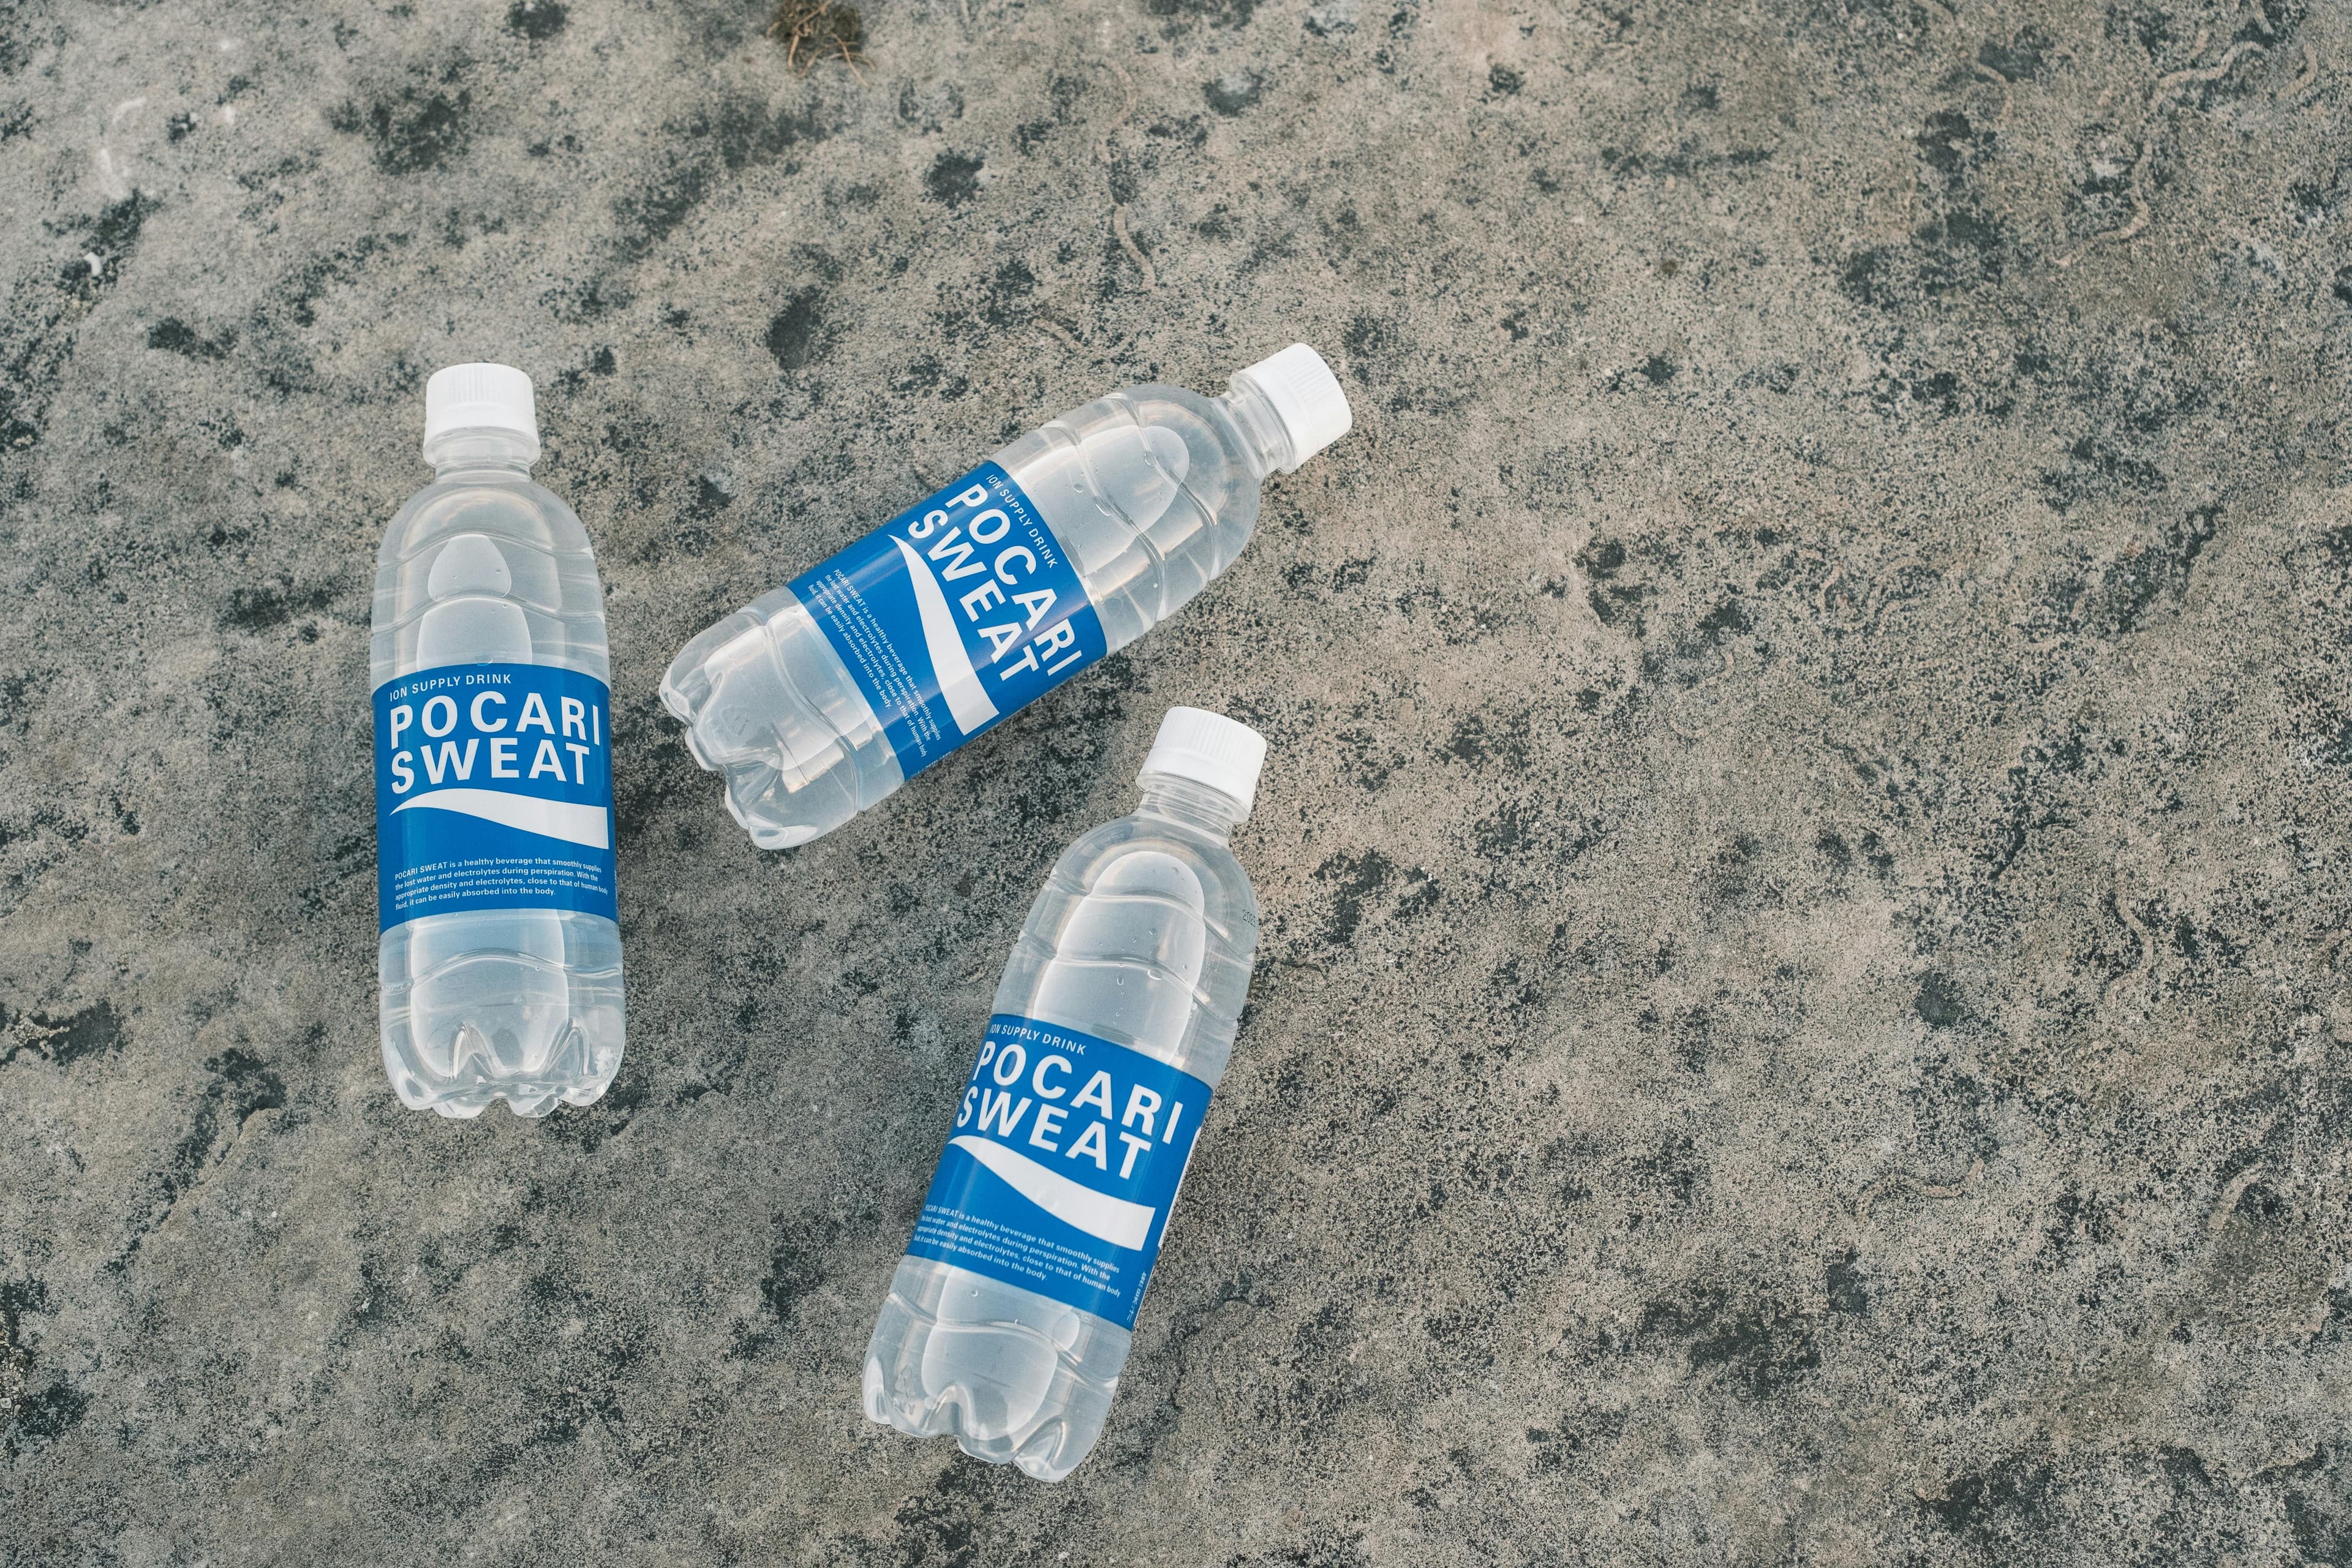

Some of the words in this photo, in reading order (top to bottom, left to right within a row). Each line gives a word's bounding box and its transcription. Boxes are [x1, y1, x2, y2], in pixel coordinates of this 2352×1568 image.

[986, 474, 1004, 489] ION
[999, 489, 1033, 526] SUPPLY
[1028, 528, 1058, 568] DRINK
[908, 510, 1039, 682] SWEAT
[944, 483, 1082, 676] POCARI
[816, 580, 837, 604] appropriate
[835, 603, 853, 625] density
[850, 625, 862, 637] and
[859, 638, 886, 680] electrolytes,
[884, 679, 897, 697] close
[900, 705, 910, 720] that
[910, 725, 922, 746] human
[919, 744, 927, 757] body
[818, 598, 827, 608] can
[825, 606, 832, 615] be
[831, 614, 845, 633] easily
[843, 632, 867, 663] absorbed
[863, 662, 874, 677] into
[872, 677, 881, 690] the
[879, 690, 892, 709] body.
[829, 580, 839, 590] lost
[836, 589, 850, 604] water
[848, 604, 860, 616] and
[856, 616, 883, 654] electrolytes
[881, 654, 897, 678] during
[893, 677, 919, 718] perspiration.
[918, 717, 927, 733] With
[833, 569, 850, 587] POCARI
[847, 586, 867, 607] SWEAT
[870, 618, 889, 644] healthy
[887, 643, 908, 676] beverage
[905, 675, 917, 690] that
[913, 690, 932, 720] smoothly
[929, 719, 941, 741] supplies
[390, 687, 407, 702] ION
[412, 676, 461, 694] SUPPLY
[466, 674, 512, 685] DRINK
[390, 691, 600, 750] POCARI
[391, 737, 590, 794] SWEAT
[394, 867, 418, 881] POCARI
[420, 861, 448, 873] SWEAT
[464, 858, 494, 867] healthy
[552, 859, 582, 869] smoothly
[582, 863, 601, 873] supplies
[395, 886, 429, 902] appropriate
[430, 881, 458, 891] density
[459, 879, 473, 888] and
[475, 877, 526, 886] electrolytes,
[581, 881, 598, 891] human
[598, 886, 608, 896] body
[395, 900, 409, 911] fluid,
[439, 891, 461, 899] easily
[462, 888, 500, 897] absorbed
[535, 887, 556, 896] body.
[404, 879, 415, 888] lost
[417, 875, 437, 884] water
[454, 867, 500, 877] electrolytes
[530, 869, 576, 877] perspiration.
[576, 871, 590, 880] With
[590, 873, 598, 882] the
[989, 1023, 1001, 1034] ION
[1001, 1024, 1040, 1041] SUPPLY
[1042, 1033, 1087, 1055] DRINK
[972, 1041, 1183, 1145] POCARI
[957, 1086, 1152, 1180] SWEAT
[932, 1216, 946, 1226] water
[959, 1224, 1001, 1242] electrolytes
[1002, 1237, 1028, 1252] during
[1029, 1247, 1079, 1269] perspiration.
[1081, 1263, 1098, 1276] With
[1099, 1271, 1110, 1281] the
[937, 1228, 959, 1242] density
[959, 1235, 973, 1244] and
[974, 1239, 1020, 1261] electrolytes,
[1023, 1255, 1043, 1267] close
[1045, 1262, 1054, 1271] to
[1055, 1266, 1072, 1278] that
[1082, 1275, 1106, 1291] human
[1106, 1284, 1121, 1298] body
[938, 1206, 959, 1217] SWEAT
[971, 1215, 999, 1231] healthy
[1000, 1224, 1036, 1242] beverage
[1038, 1237, 1055, 1249] that
[1056, 1245, 1092, 1264] smoothly
[1093, 1258, 1120, 1273] supplies
[939, 1240, 957, 1252] easily
[958, 1245, 993, 1261] absorbed
[993, 1256, 1009, 1267] into
[1011, 1262, 1025, 1272] the
